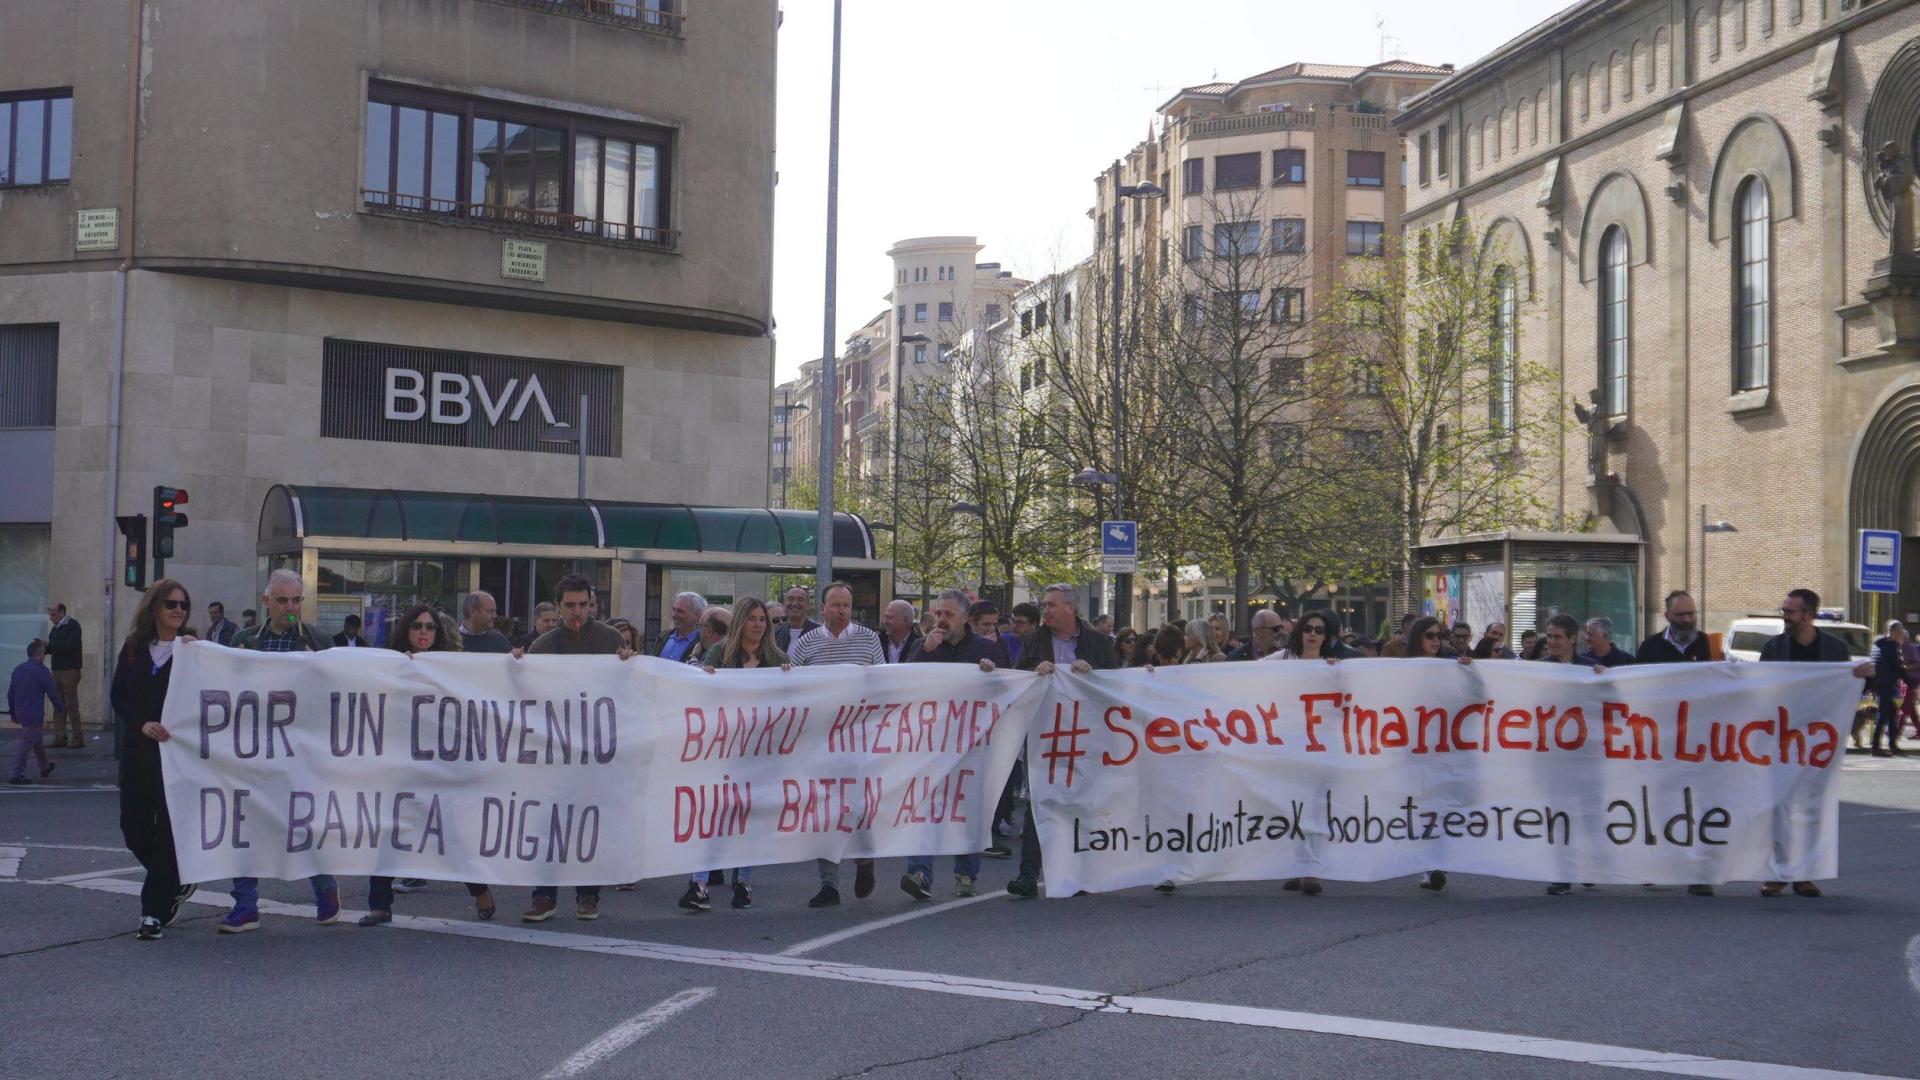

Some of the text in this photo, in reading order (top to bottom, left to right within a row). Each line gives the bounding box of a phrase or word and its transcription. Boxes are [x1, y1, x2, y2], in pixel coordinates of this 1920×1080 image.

[385, 367, 557, 427] BBVA
[199, 689, 618, 766] POR UN CONVENIO
[680, 706, 810, 763] BANKU
[199, 787, 601, 864] DE BANCA DIGNO
[673, 774, 752, 843] DUIN
[777, 776, 883, 834] BATEN
[1326, 789, 1571, 846] hobetzearen
[1606, 784, 1732, 848] alde
